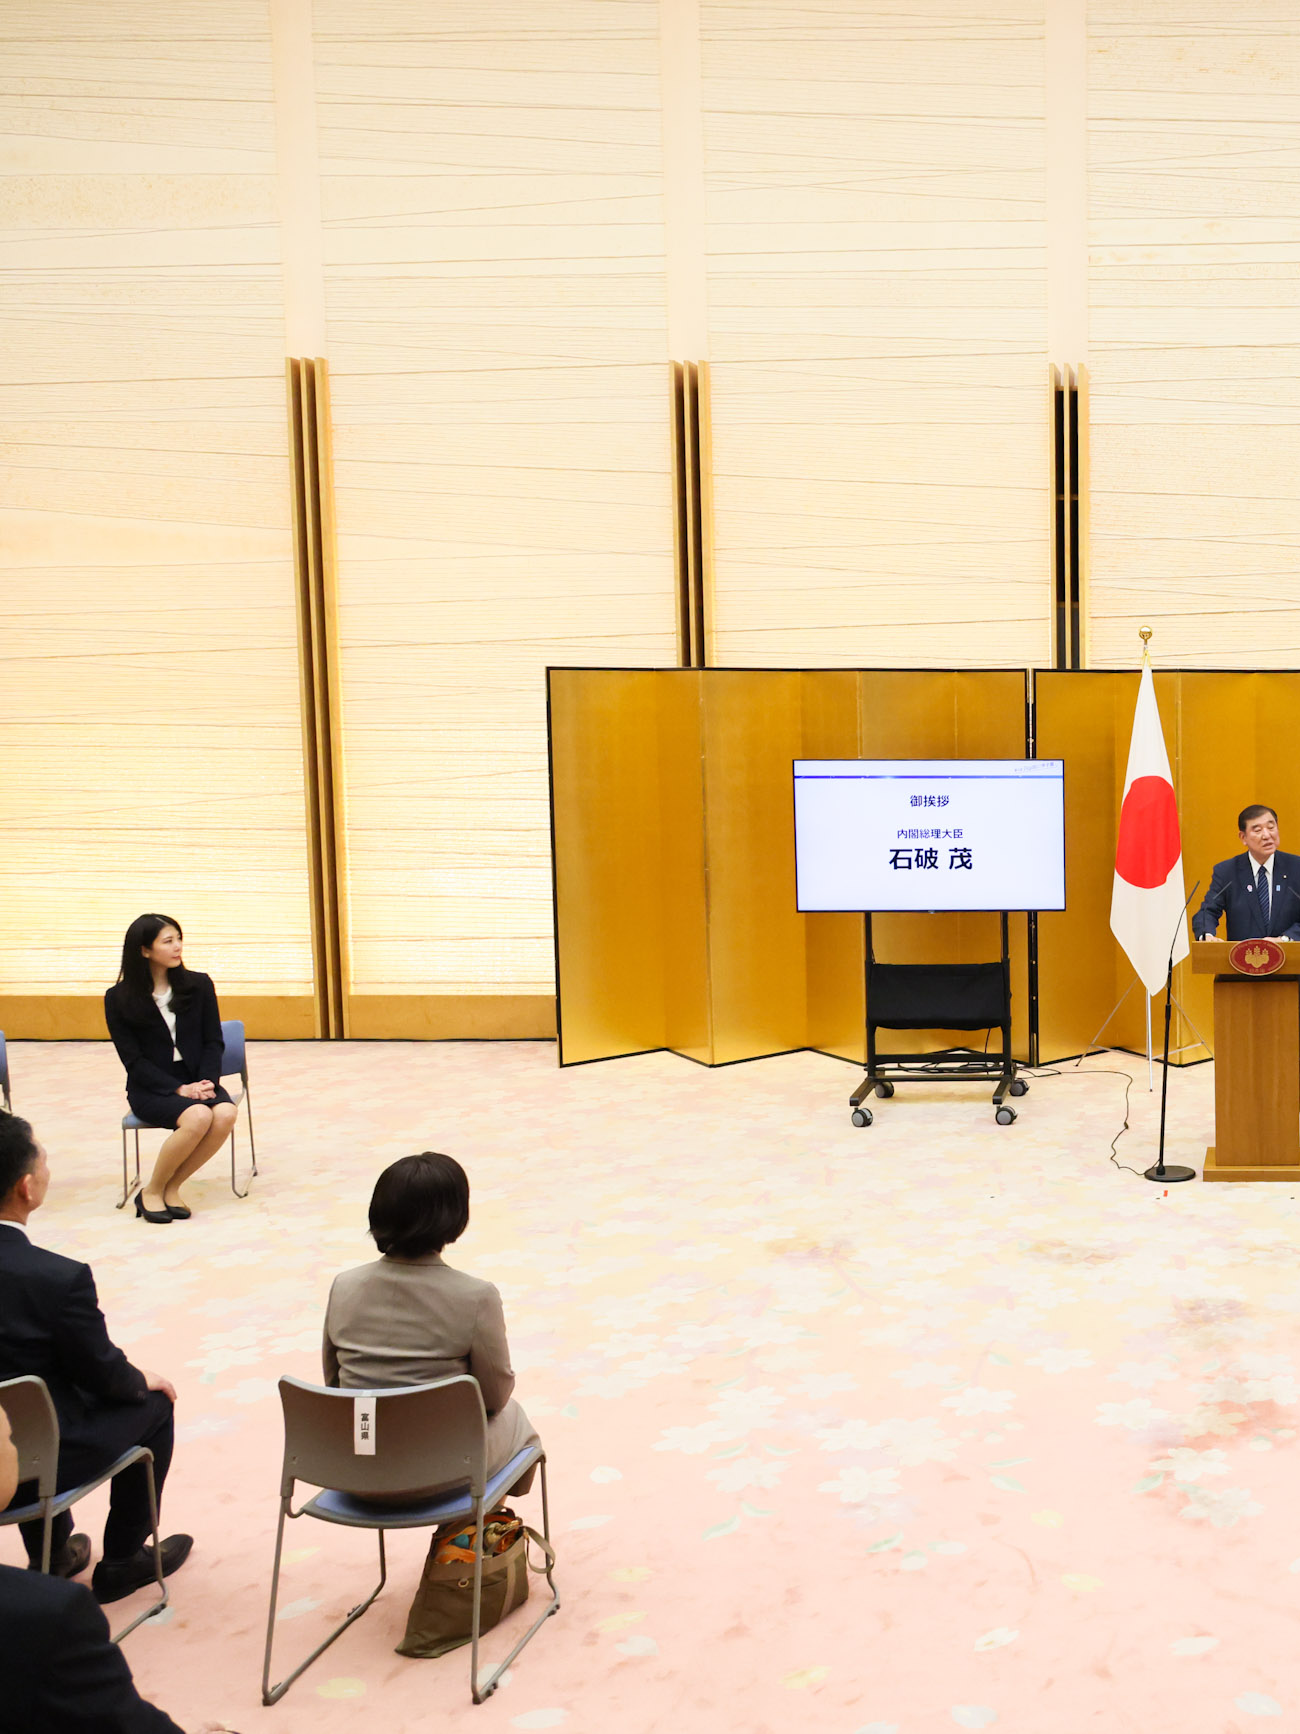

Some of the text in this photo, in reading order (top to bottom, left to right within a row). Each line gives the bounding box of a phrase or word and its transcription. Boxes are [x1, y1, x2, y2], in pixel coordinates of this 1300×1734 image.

[909, 794, 950, 808] 御挨拶
[896, 828, 964, 840] 内閣総理大臣
[888, 847, 973, 870] 石破 茂
[360, 1412, 370, 1440] 富山県
